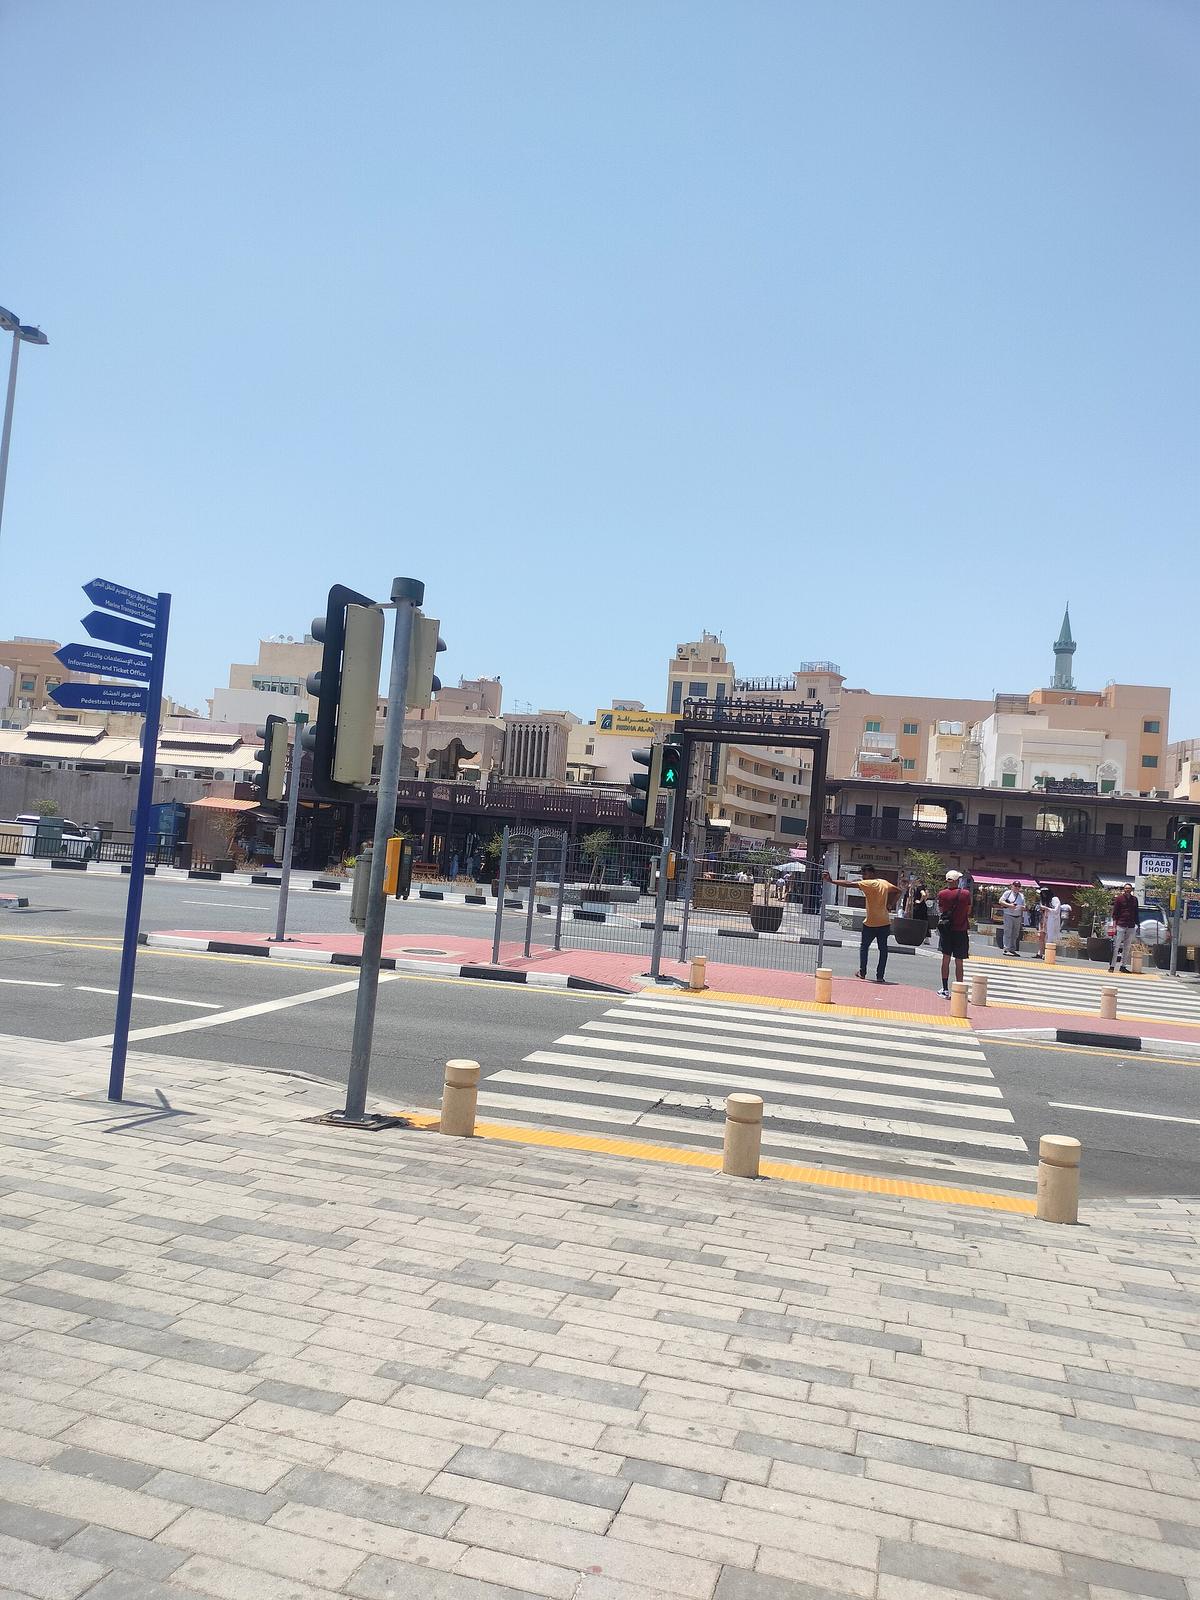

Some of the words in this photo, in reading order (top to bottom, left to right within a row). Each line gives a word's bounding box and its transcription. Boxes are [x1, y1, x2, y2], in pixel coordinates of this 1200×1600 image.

[120, 604, 141, 617] Transport
[82, 651, 103, 660] والتذاكر
[67, 658, 101, 670] Information
[112, 666, 129, 675] Ticket
[129, 669, 147, 677] Office
[111, 699, 141, 709] Underpass
[778, 715, 825, 728] STREET
[1148, 866, 1171, 874] HOUR
